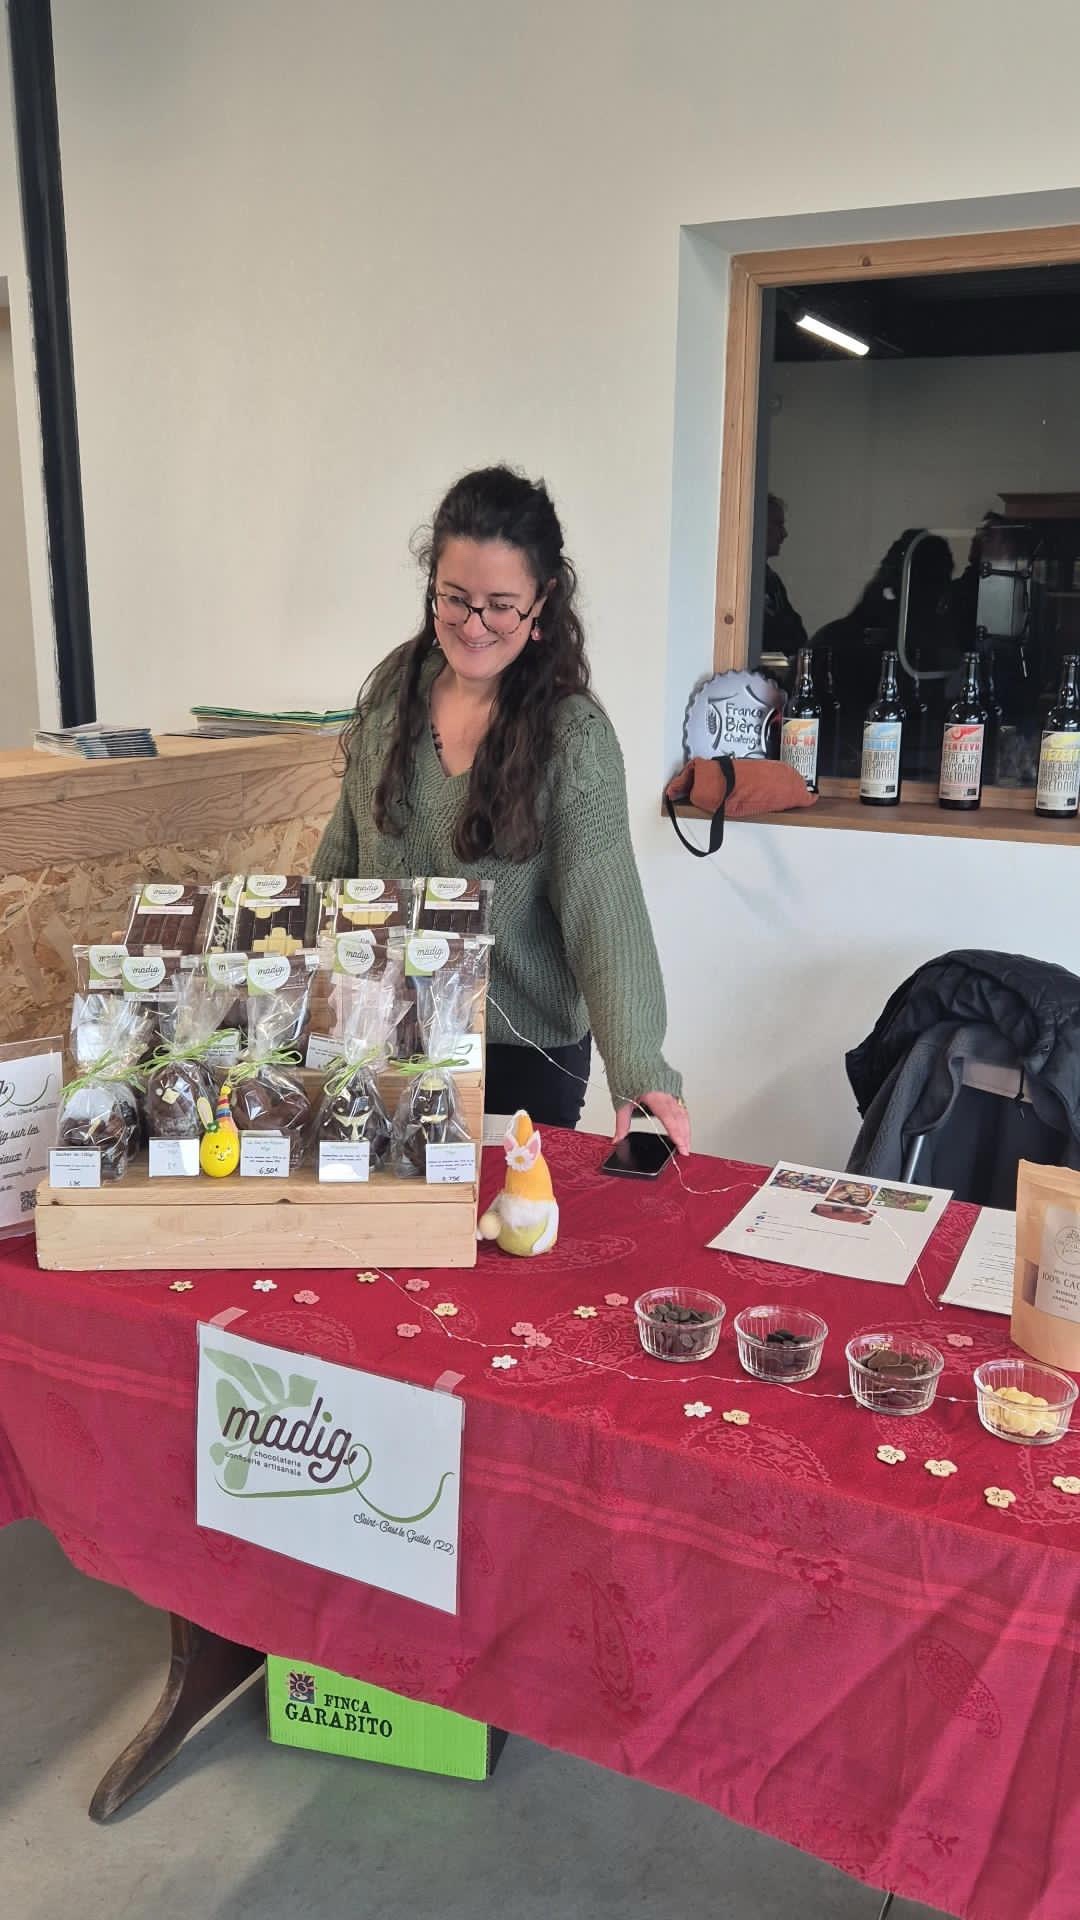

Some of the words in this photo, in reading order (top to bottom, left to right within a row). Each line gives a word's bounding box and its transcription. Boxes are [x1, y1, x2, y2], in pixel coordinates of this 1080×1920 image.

[725, 716, 763, 735] Bière
[345, 950, 370, 963] madig
[416, 946, 443, 960] madig
[132, 964, 161, 977] madig
[222, 1397, 353, 1483] madig
[225, 1451, 261, 1467] confiserie
[263, 1462, 302, 1477] artisanale
[254, 1450, 302, 1468] chocolaterie
[406, 1529, 431, 1546] Guildo
[433, 1539, 455, 1556] (22)
[324, 1694, 372, 1714] FINCA
[285, 1702, 393, 1738] GARABITO
